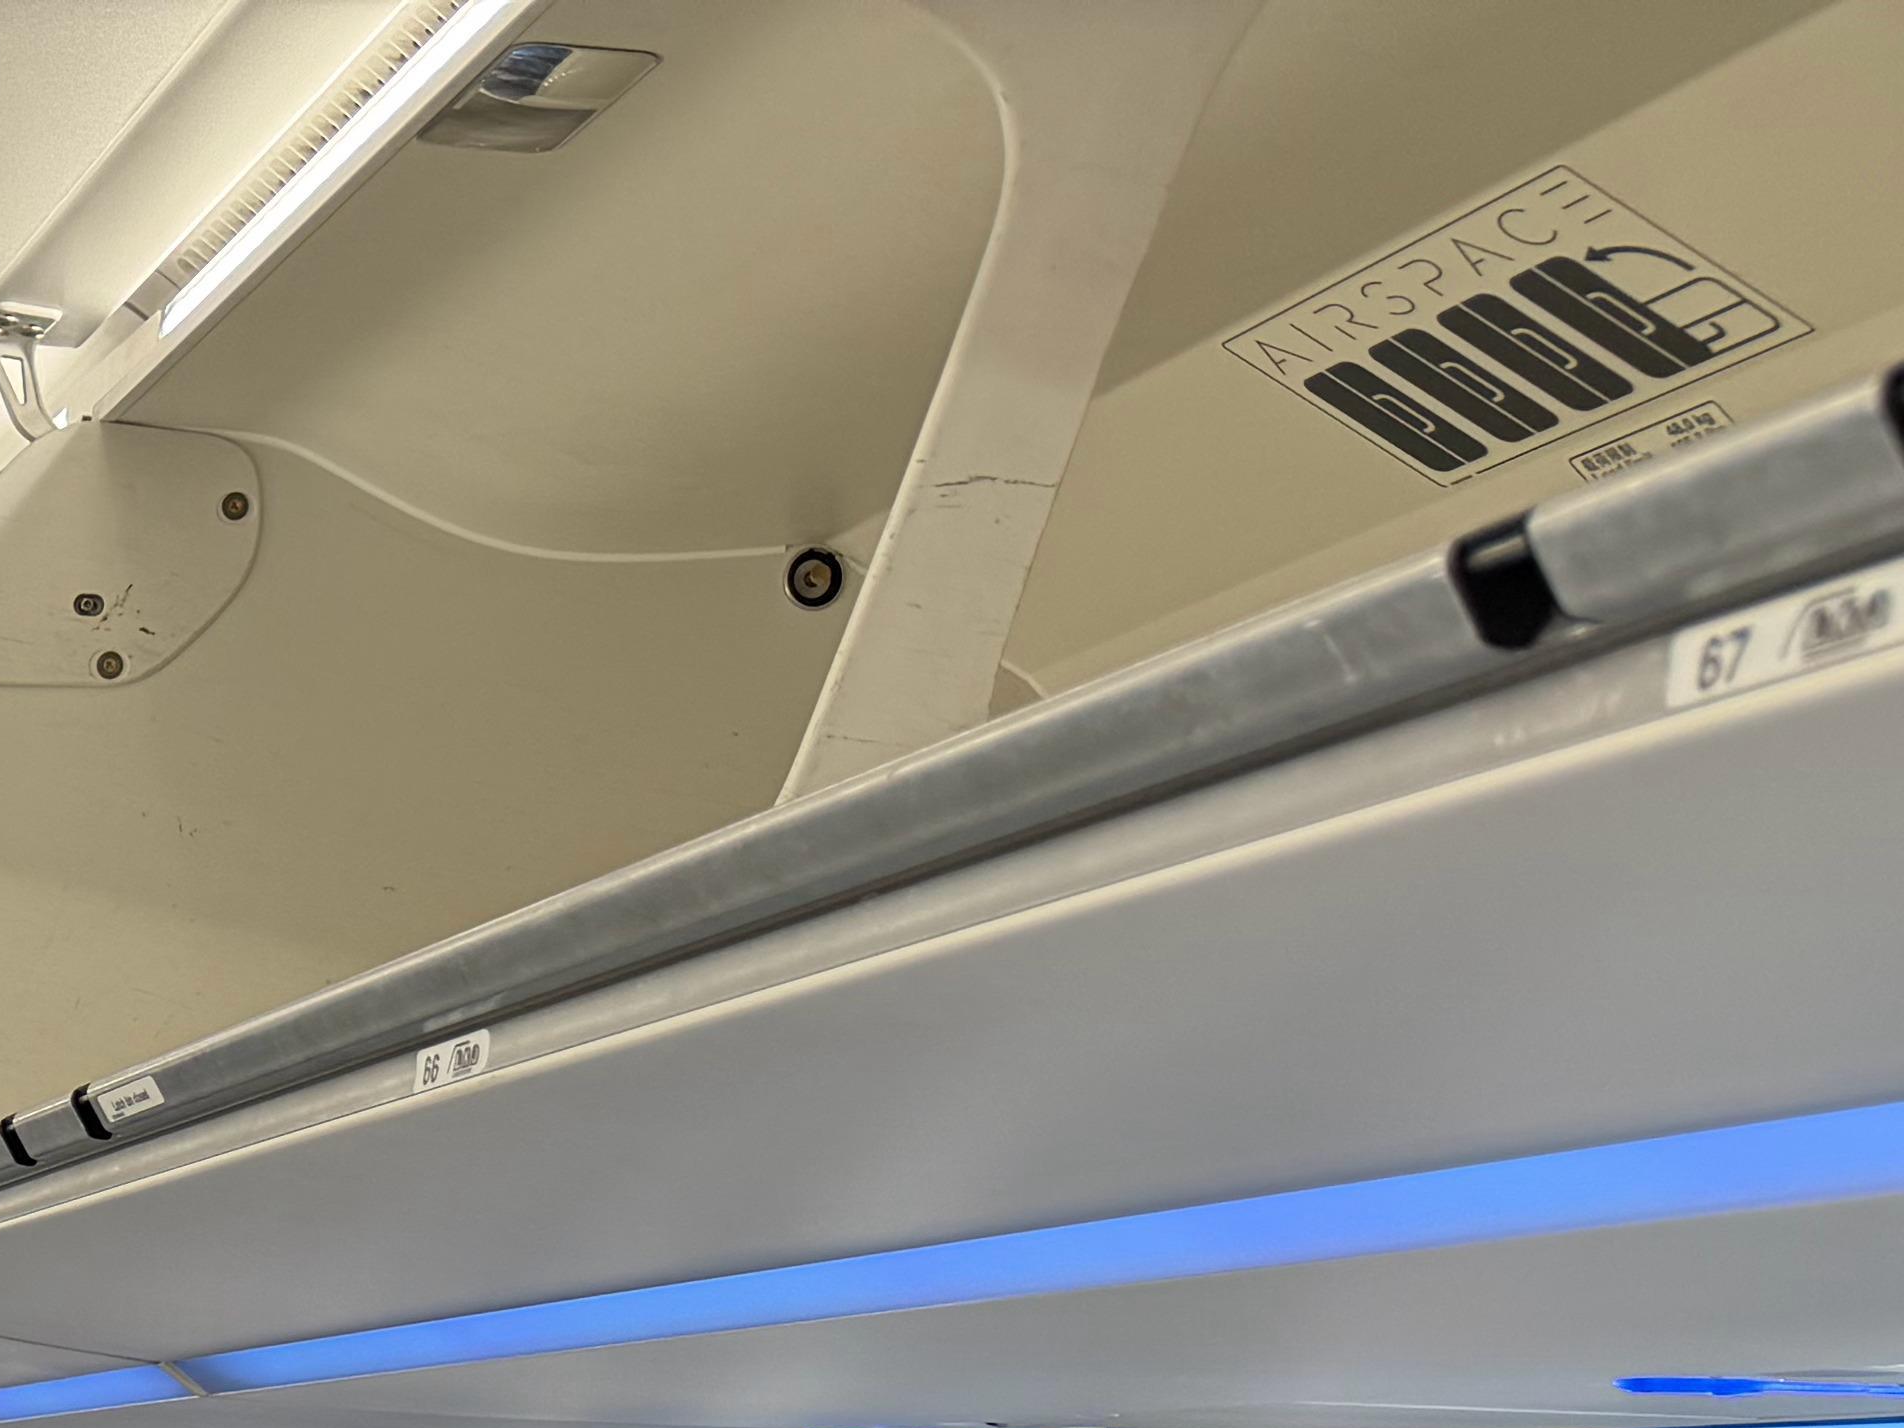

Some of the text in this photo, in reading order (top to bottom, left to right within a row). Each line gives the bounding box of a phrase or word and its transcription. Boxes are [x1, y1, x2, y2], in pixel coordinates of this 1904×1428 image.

[1255, 180, 1613, 375] AIRSPACE
[1696, 628, 1751, 691] 67
[422, 1053, 440, 1086] 66
